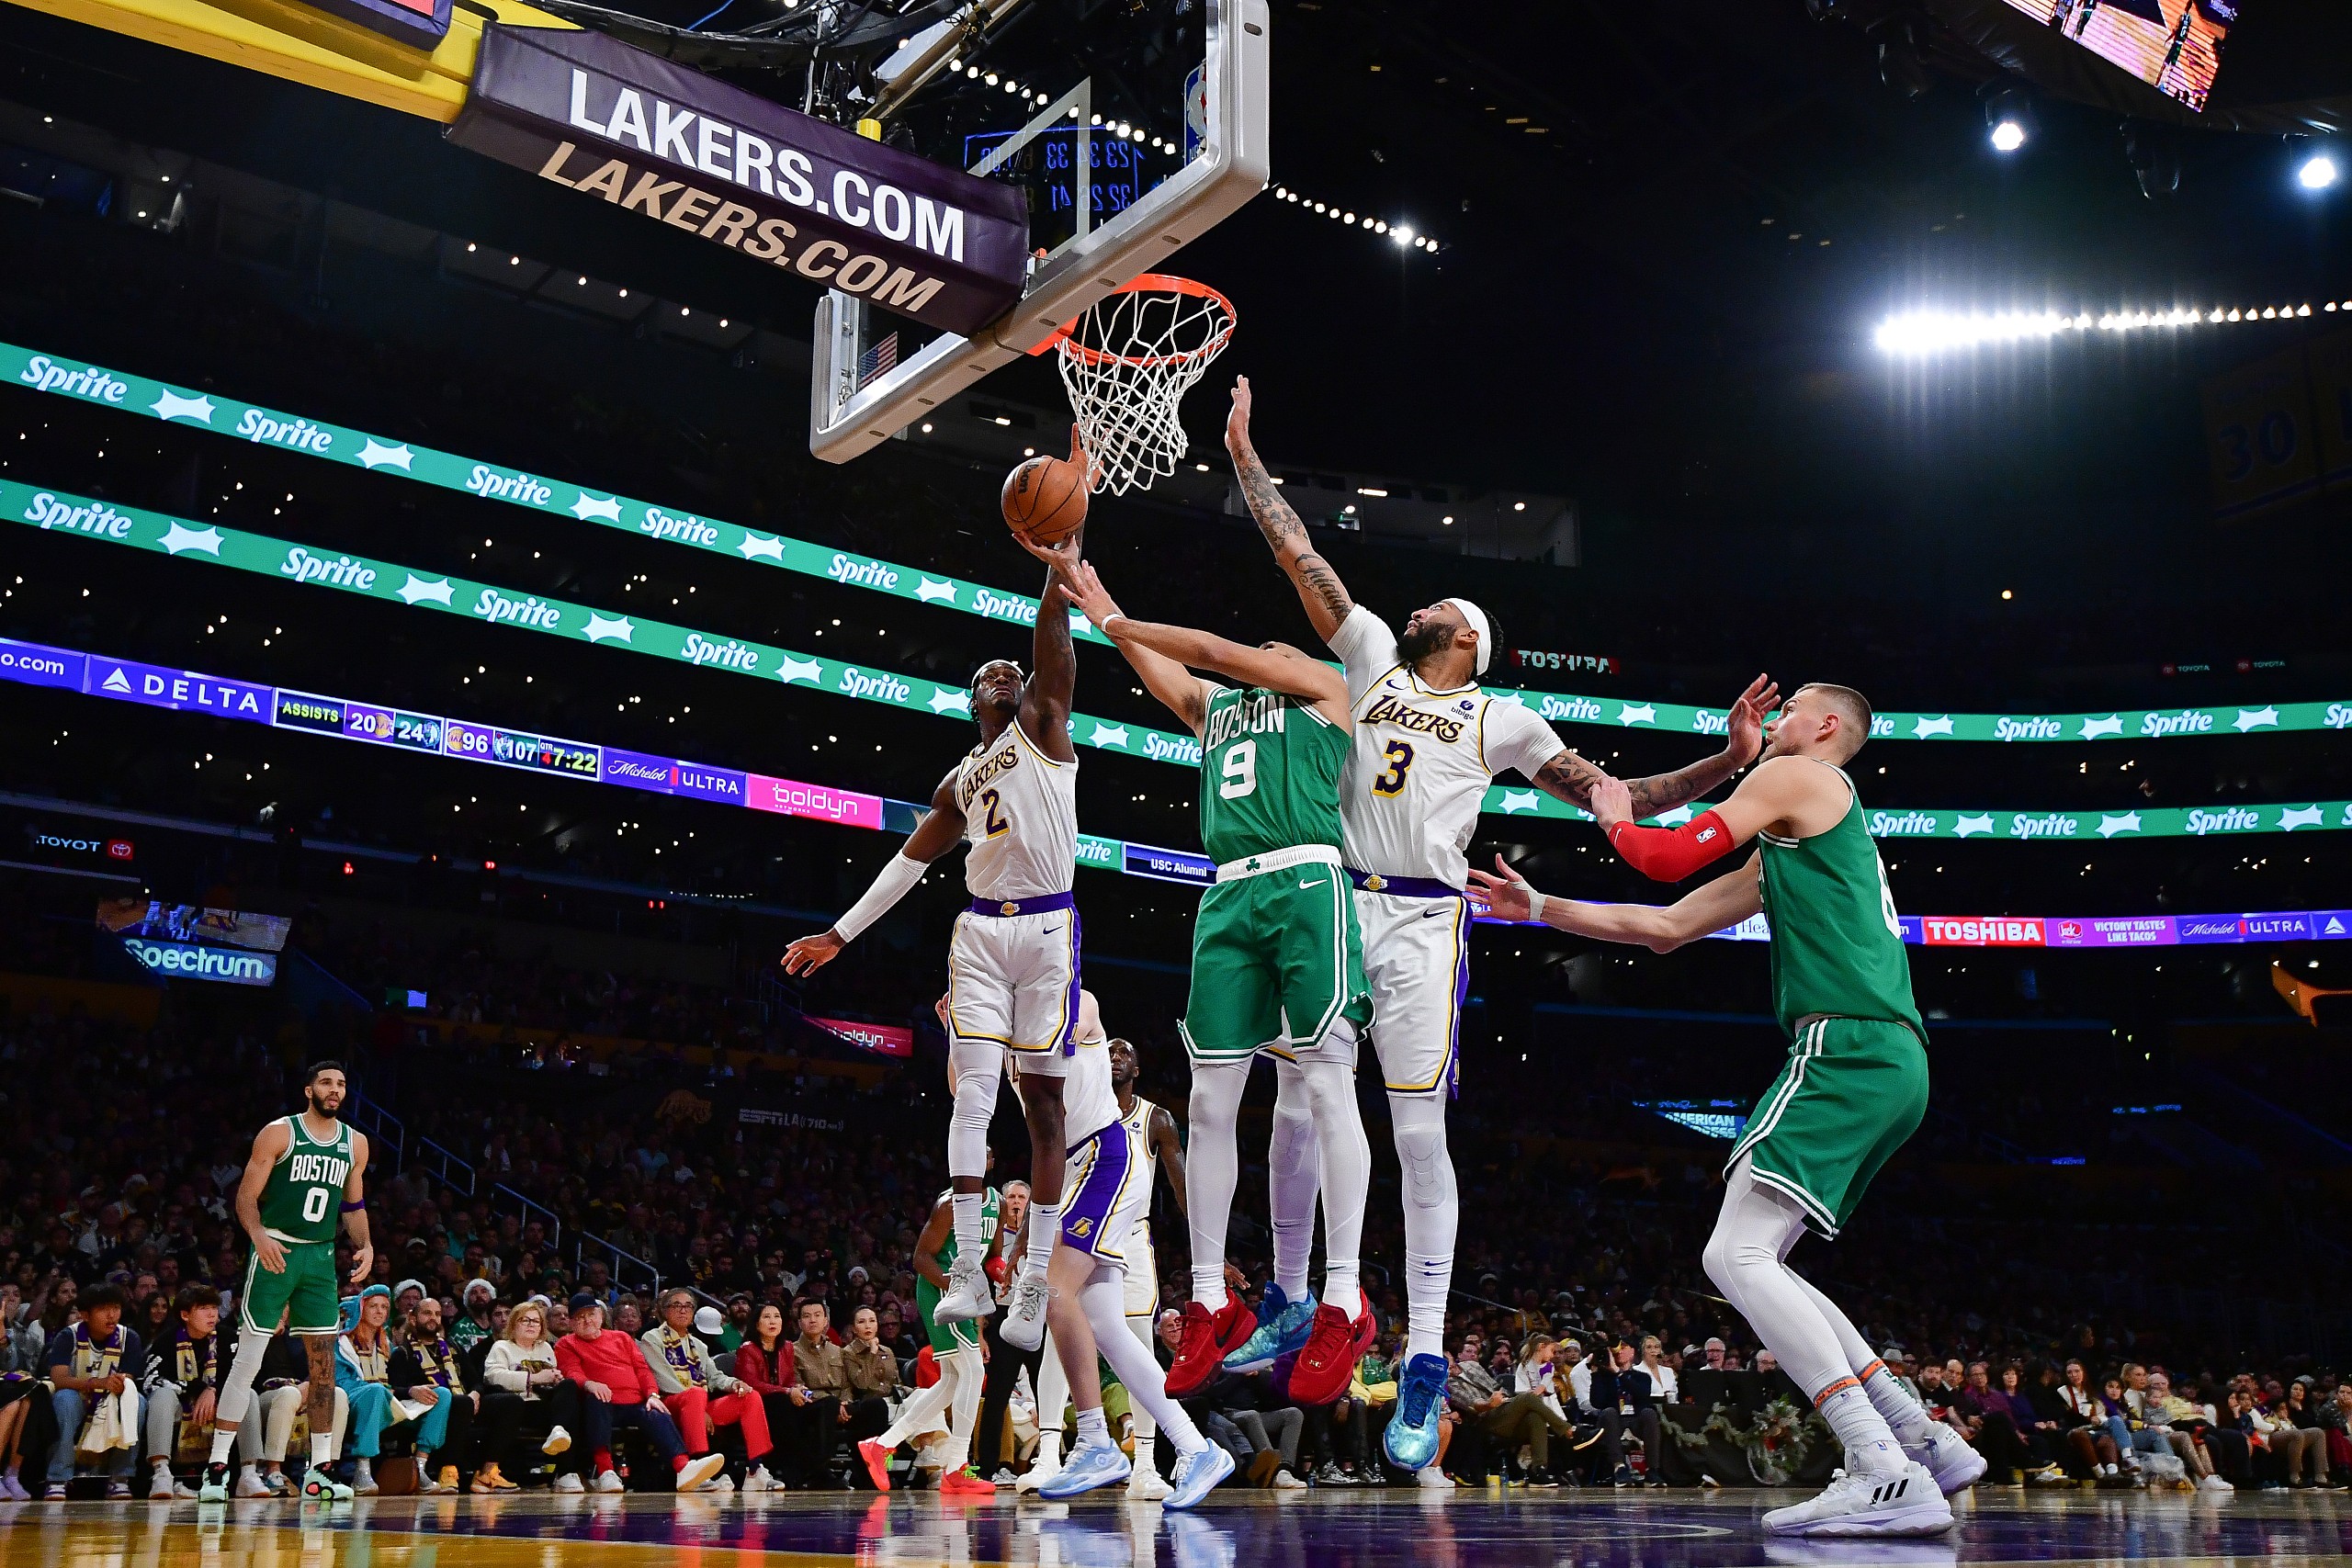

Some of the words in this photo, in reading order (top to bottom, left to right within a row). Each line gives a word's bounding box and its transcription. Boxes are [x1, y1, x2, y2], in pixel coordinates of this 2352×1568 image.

[568, 68, 965, 264] LAKERS.COM
[538, 141, 946, 313] LAKERS.COM
[20, 355, 128, 402] Sprite
[236, 409, 333, 452] Sprite
[466, 465, 552, 505] Sprite
[25, 492, 132, 537] Sprite
[640, 507, 718, 546] Sprite
[280, 547, 377, 589] Sprite
[828, 553, 899, 590] Sprite
[475, 589, 560, 628] Sprite
[972, 589, 1038, 623] Sprite
[681, 633, 759, 671] Sprite
[143, 673, 260, 714] DELTA
[840, 667, 910, 703] Sprite
[282, 701, 339, 723] ASSISTS
[1204, 694, 1285, 753] BOSTON
[1358, 694, 1465, 744] LAKERS
[1451, 706, 1475, 720] bibigo
[1538, 694, 1602, 721] Sprite
[2141, 710, 2213, 738] Sprite
[349, 712, 376, 734] 20
[398, 720, 424, 742] 24
[1994, 716, 2063, 742] Sprite
[462, 731, 489, 753] 96
[504, 739, 537, 762] 107
[553, 748, 597, 773] 7:22
[1142, 731, 1203, 764] Sprite
[607, 760, 667, 782] Michelob
[683, 771, 740, 795] ULTRA
[961, 744, 1019, 813] LAKERS
[1219, 739, 1257, 800] 9
[1372, 738, 1416, 799] 3
[772, 783, 858, 818] boldyn
[980, 787, 1010, 840] 2
[1869, 810, 1937, 839] Sprite
[2010, 813, 2077, 840] Sprite
[2185, 807, 2259, 836] Sprite
[1076, 840, 1112, 862] prite
[1150, 858, 1172, 872] USC
[1173, 862, 1207, 877] Alumni
[1928, 920, 2041, 942] TOSHIBA
[2094, 920, 2132, 931] VICTORY
[2132, 919, 2166, 931] TASTES
[2107, 932, 2128, 942] LIKE
[2129, 931, 2157, 942] TACOS
[2182, 922, 2235, 937] Michelob
[2249, 919, 2305, 933] ULTRA
[289, 1154, 350, 1189] BOSTON
[302, 1186, 330, 1223] 0
